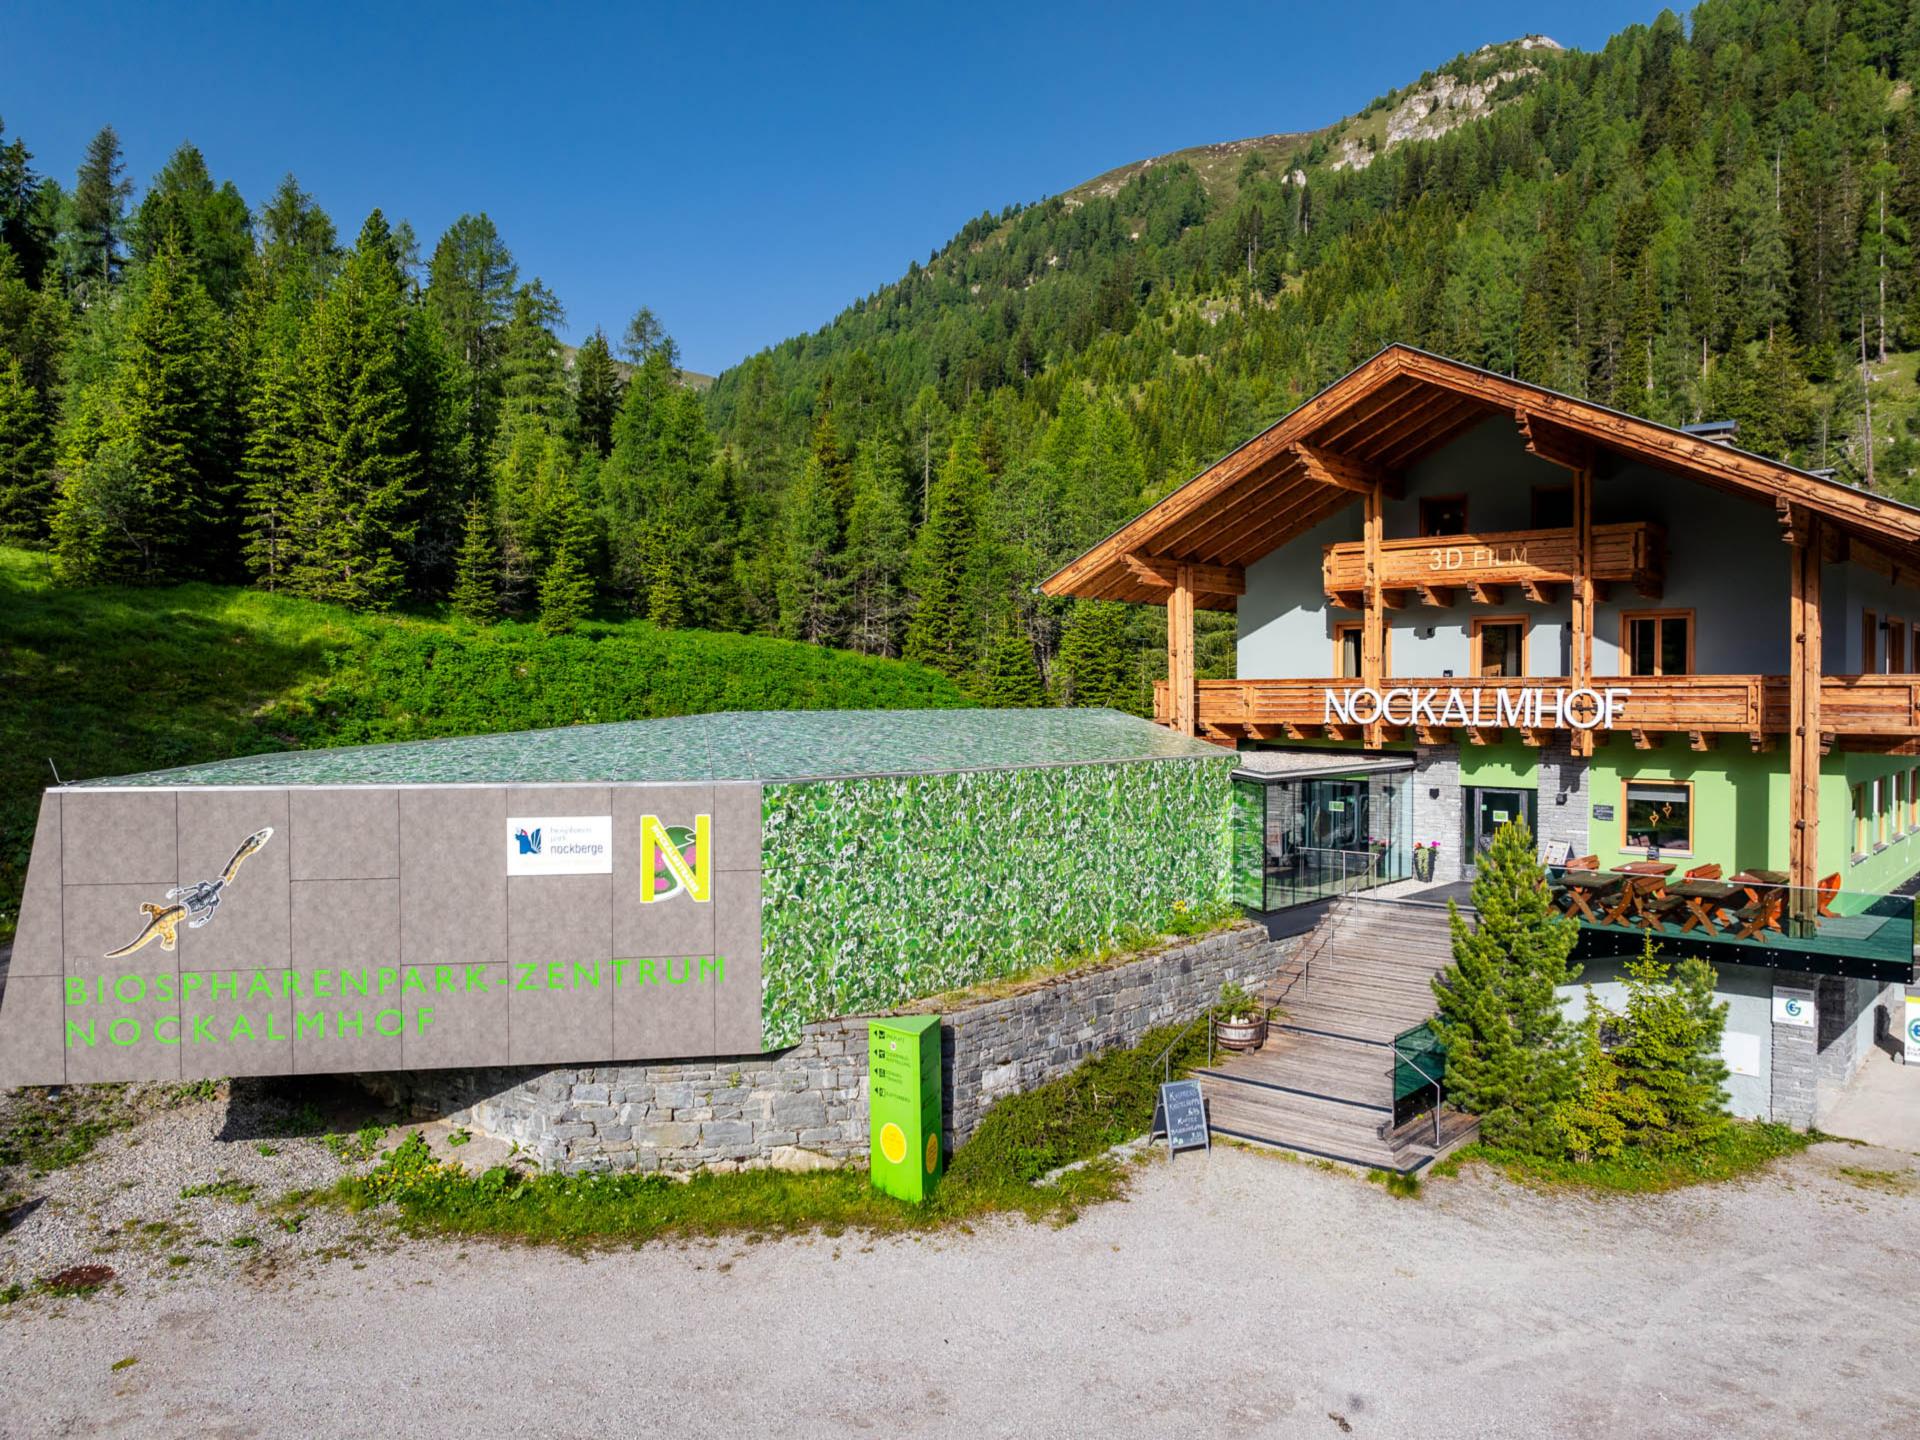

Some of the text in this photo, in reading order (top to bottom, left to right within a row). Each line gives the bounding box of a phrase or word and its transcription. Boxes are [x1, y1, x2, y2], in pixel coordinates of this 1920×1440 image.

[1429, 547, 1528, 571] 3D FILM
[1323, 687, 1632, 730] NOCKALMHOF
[550, 842, 604, 856] nockberge
[65, 956, 726, 1006] BIOSPHÄRENPARK-ZENTRUM
[65, 1007, 435, 1048] NOCKALMHOF
